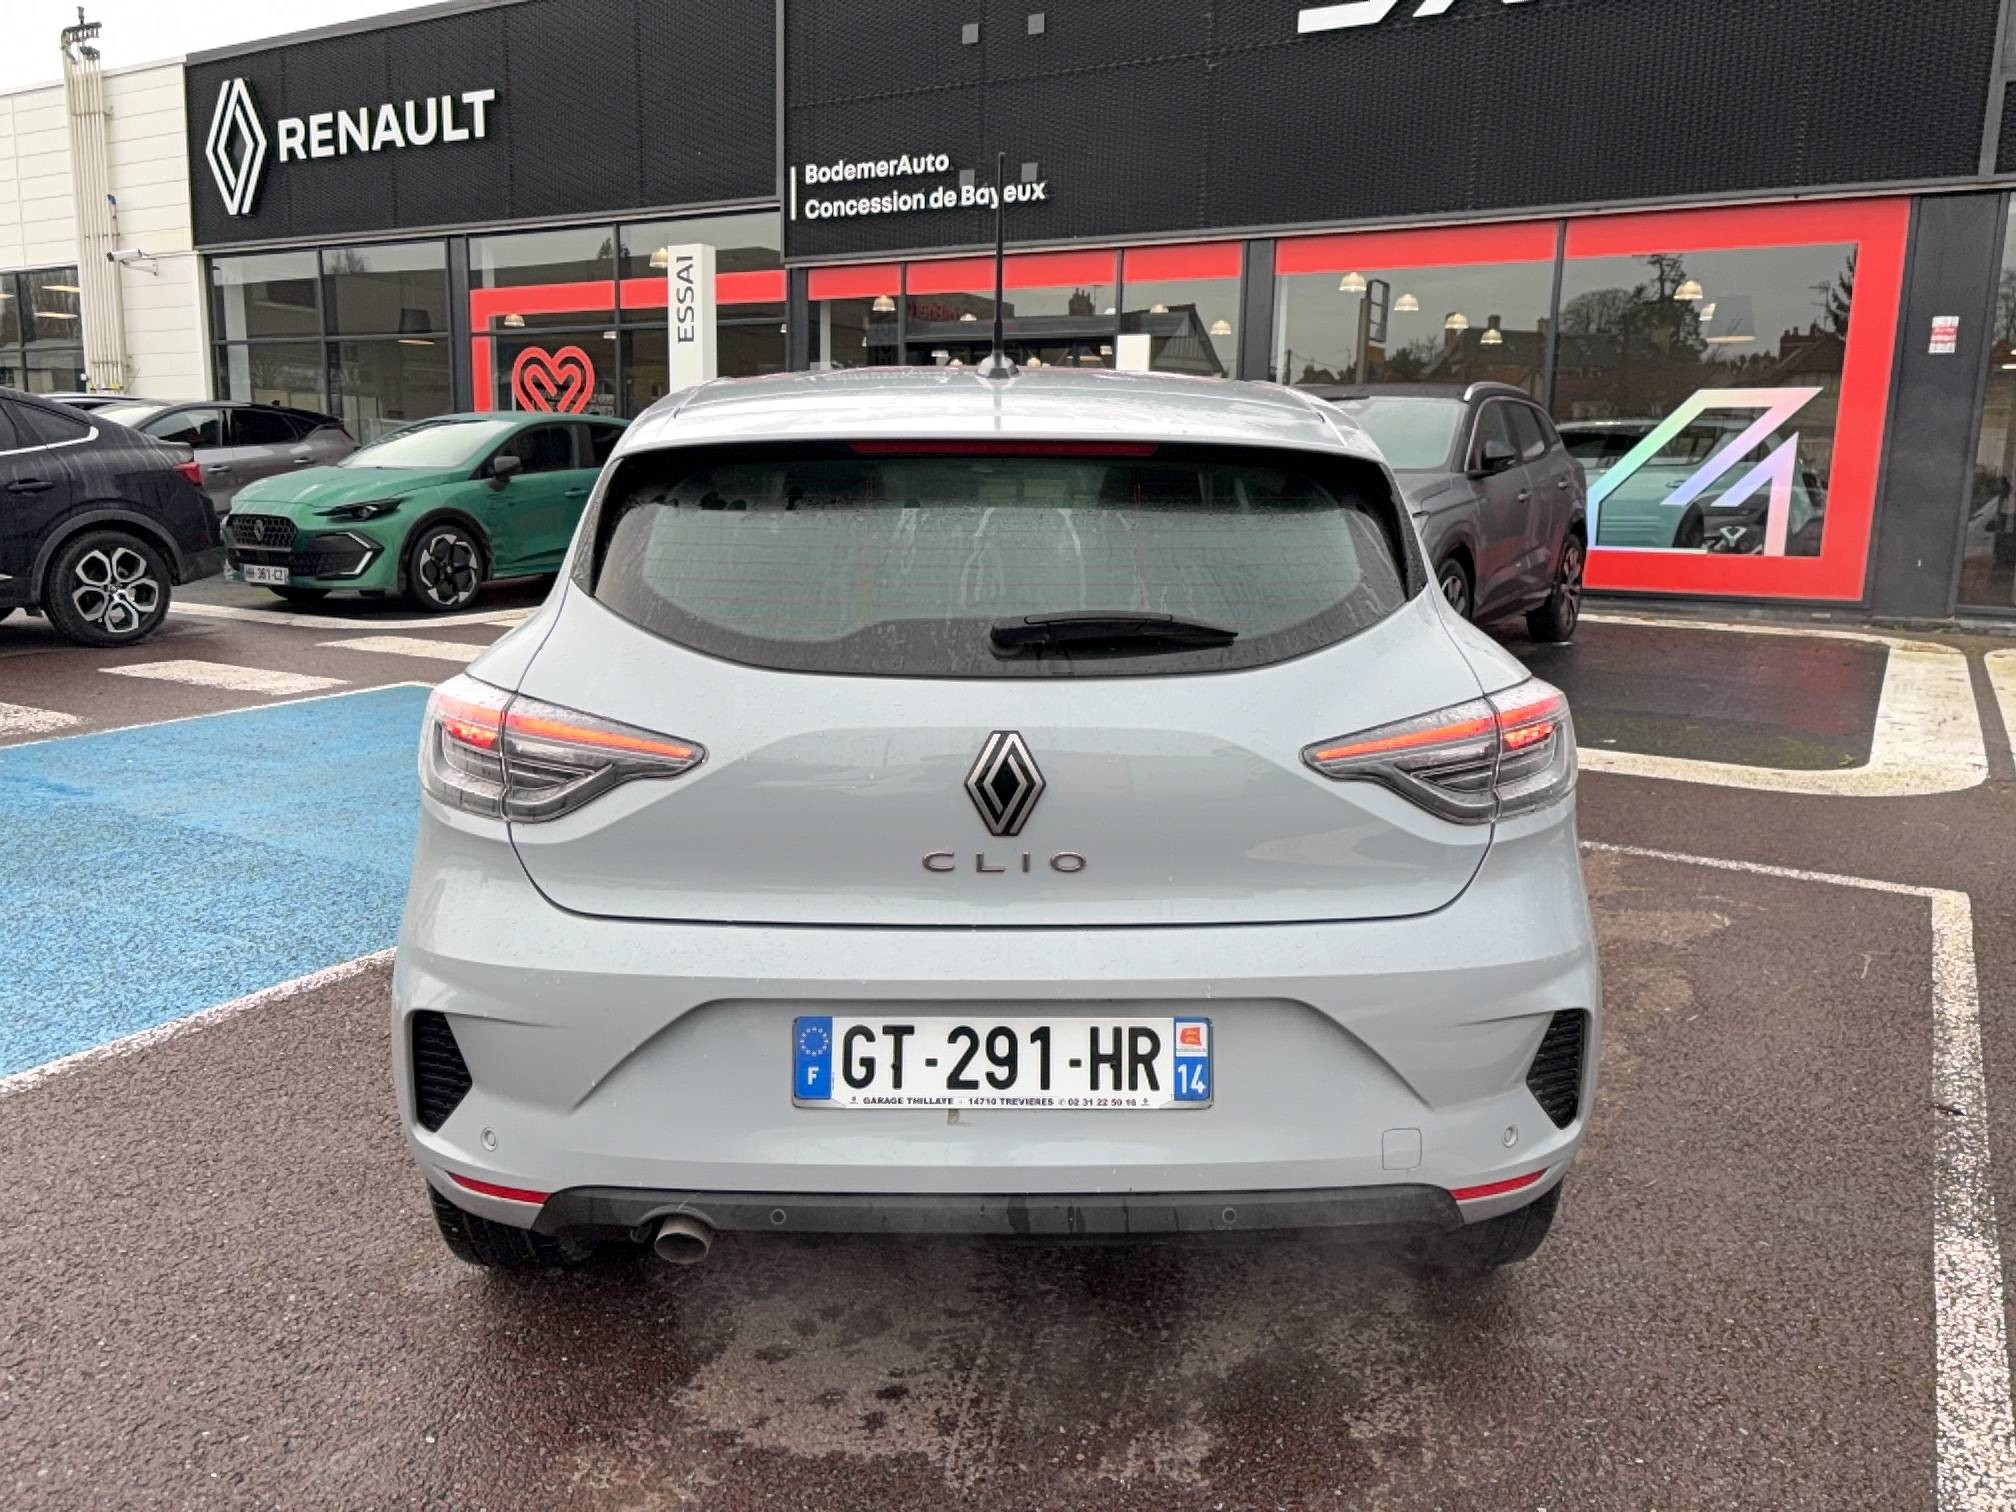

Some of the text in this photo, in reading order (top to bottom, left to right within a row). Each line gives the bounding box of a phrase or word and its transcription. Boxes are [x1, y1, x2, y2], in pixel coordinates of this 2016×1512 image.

[277, 89, 496, 163] RENAULT
[804, 153, 950, 185] BodemerAuto
[804, 181, 1046, 220] Concession de Bayeux
[676, 255, 695, 344] ESSAI
[922, 851, 1086, 873] CLIO
[842, 1025, 1161, 1091] GT-291-HR
[807, 1066, 819, 1086] F
[1177, 1063, 1207, 1094] 14
[863, 1096, 903, 1105] GARAGE
